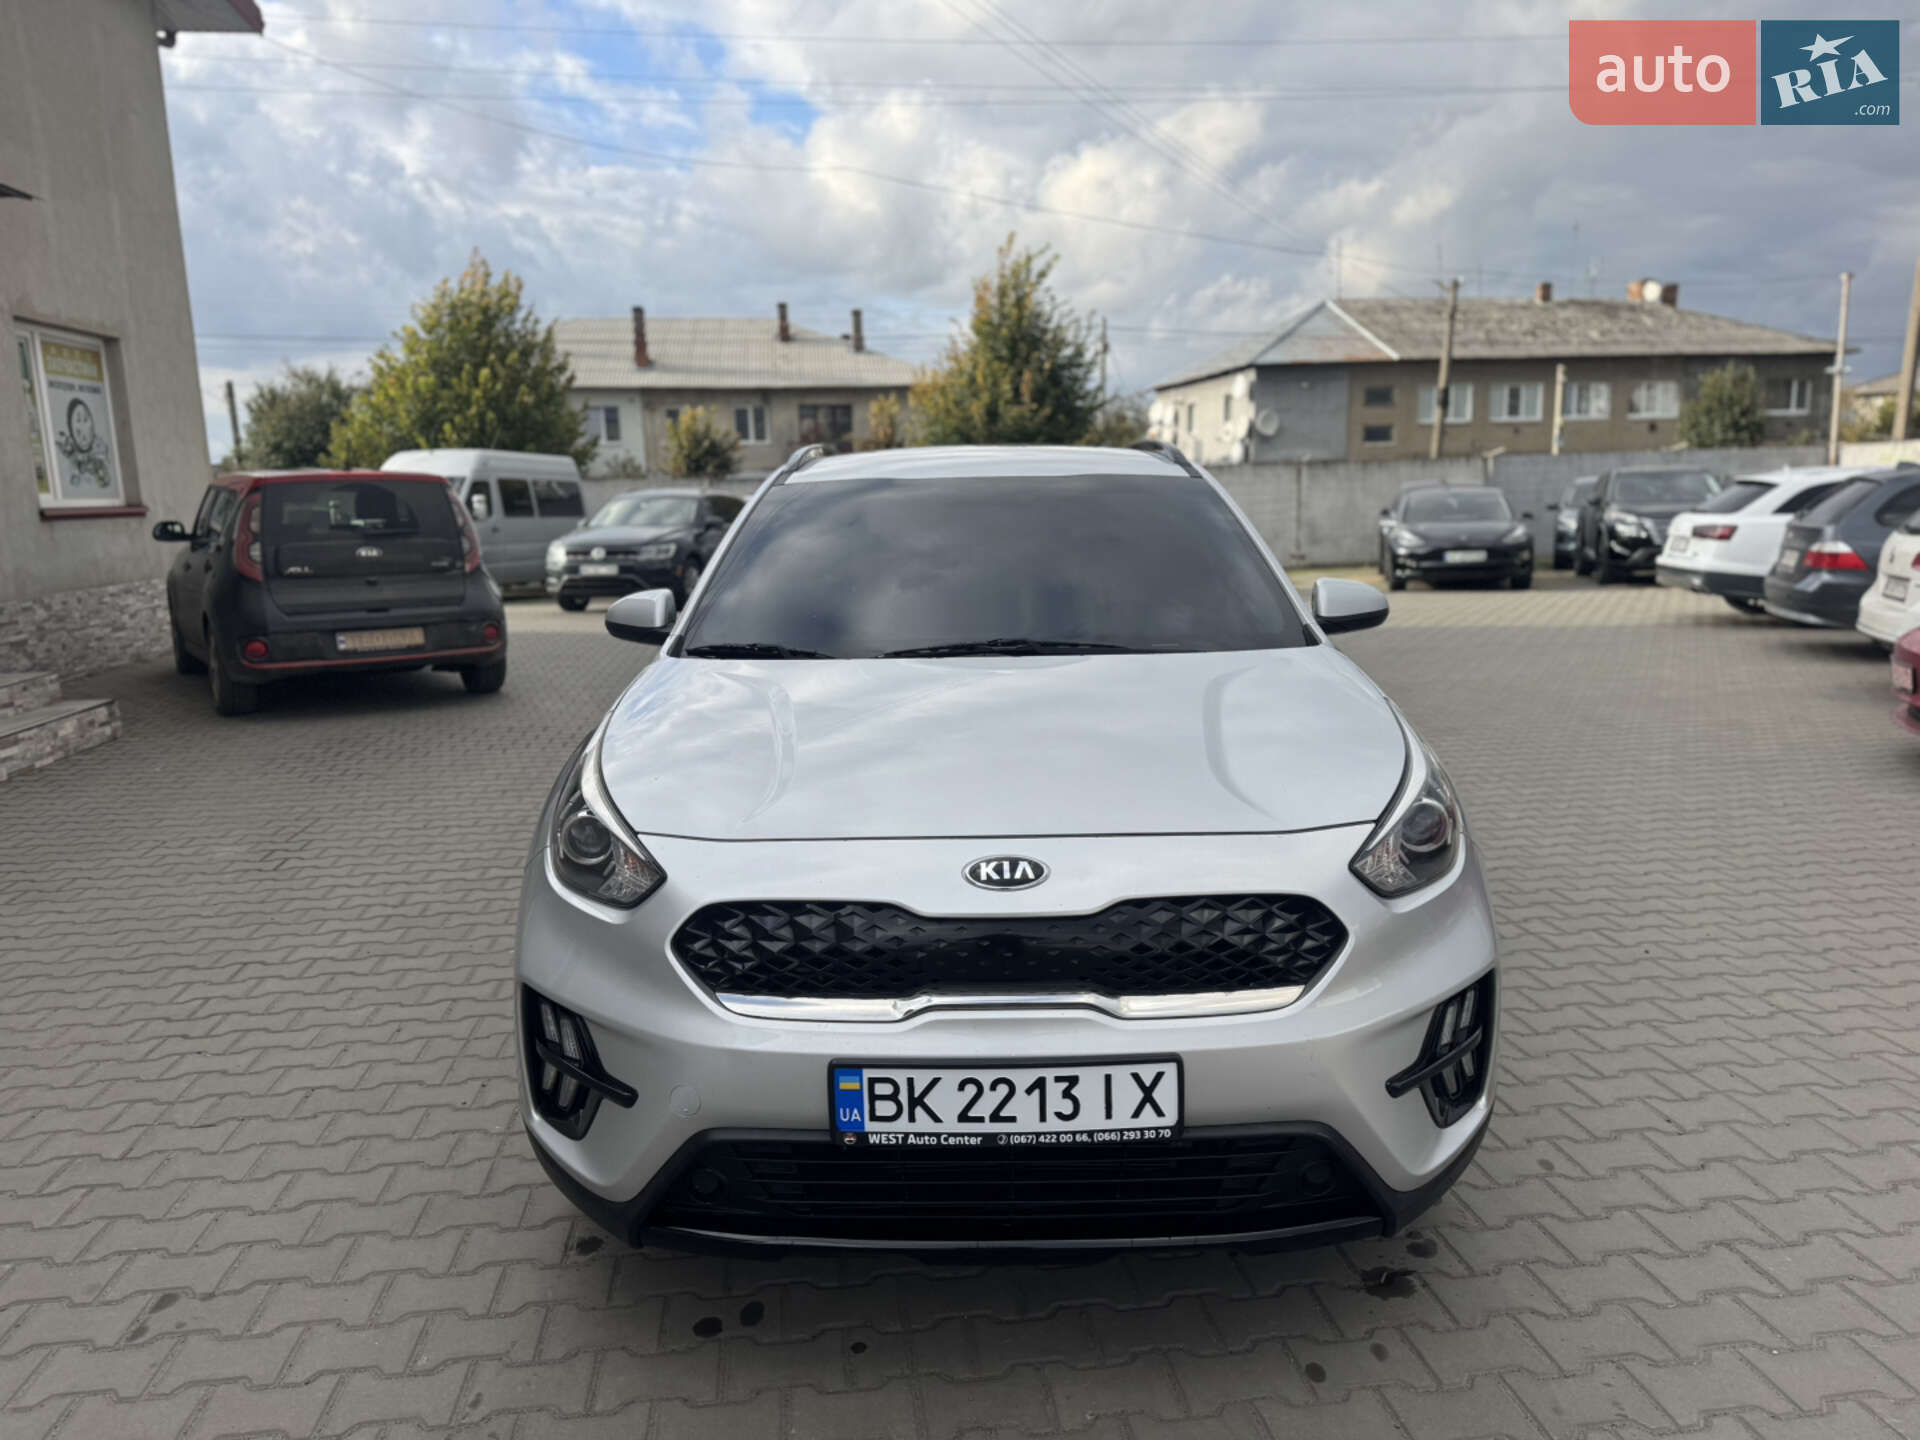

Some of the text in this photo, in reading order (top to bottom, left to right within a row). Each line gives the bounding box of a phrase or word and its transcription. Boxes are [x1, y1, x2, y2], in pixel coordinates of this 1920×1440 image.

[979, 860, 1036, 880] KIA
[866, 1070, 1167, 1124] BK 2213 IX
[839, 1108, 862, 1122] UA
[868, 1133, 905, 1145] WEST
[907, 1133, 937, 1145] Auto
[940, 1134, 983, 1145] Center
[1009, 1134, 1037, 1145] (067)
[1038, 1134, 1057, 1144] 422
[1059, 1134, 1073, 1143] 00
[1093, 1131, 1121, 1142] (066)
[1122, 1131, 1141, 1140] 293
[1143, 1130, 1156, 1139] 30
[1158, 1129, 1172, 1138] 70
